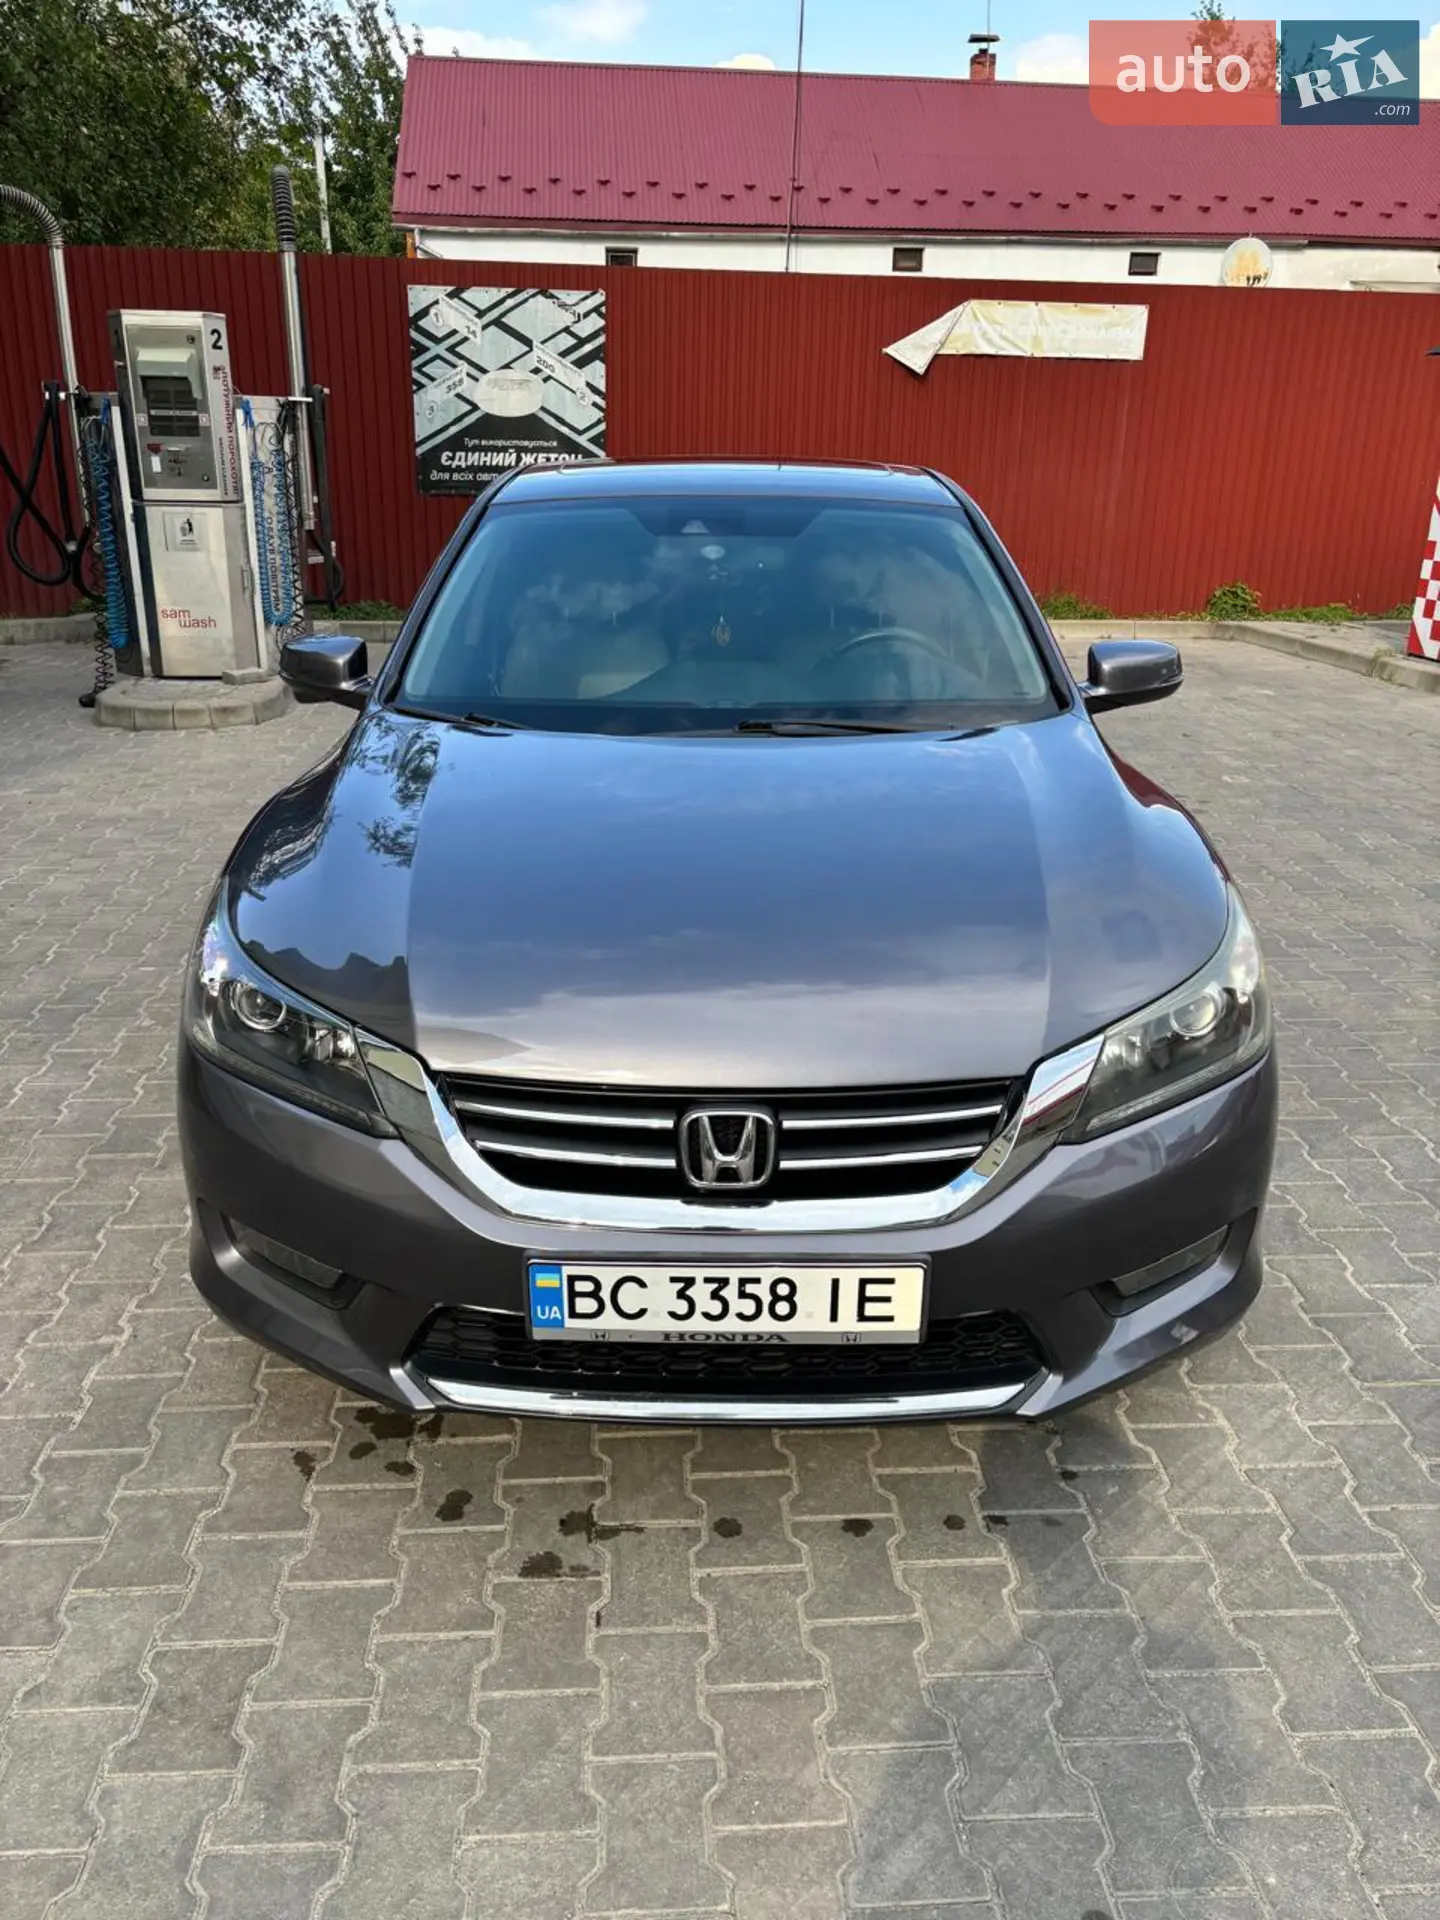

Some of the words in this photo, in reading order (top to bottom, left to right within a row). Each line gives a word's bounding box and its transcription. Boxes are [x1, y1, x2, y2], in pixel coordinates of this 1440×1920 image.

[210, 328, 223, 350] 2
[536, 355, 556, 373] 200
[464, 437, 480, 448] Тут
[441, 449, 517, 468] ЄДИНИЙ
[430, 469, 450, 481] для
[452, 471, 474, 481] всіх
[161, 607, 191, 619] sam
[179, 616, 217, 628] wash
[566, 1274, 648, 1321] BC
[667, 1276, 798, 1322] 3358
[829, 1277, 896, 1323] IE
[537, 1305, 562, 1320] UA
[662, 1332, 789, 1343] HONDA
